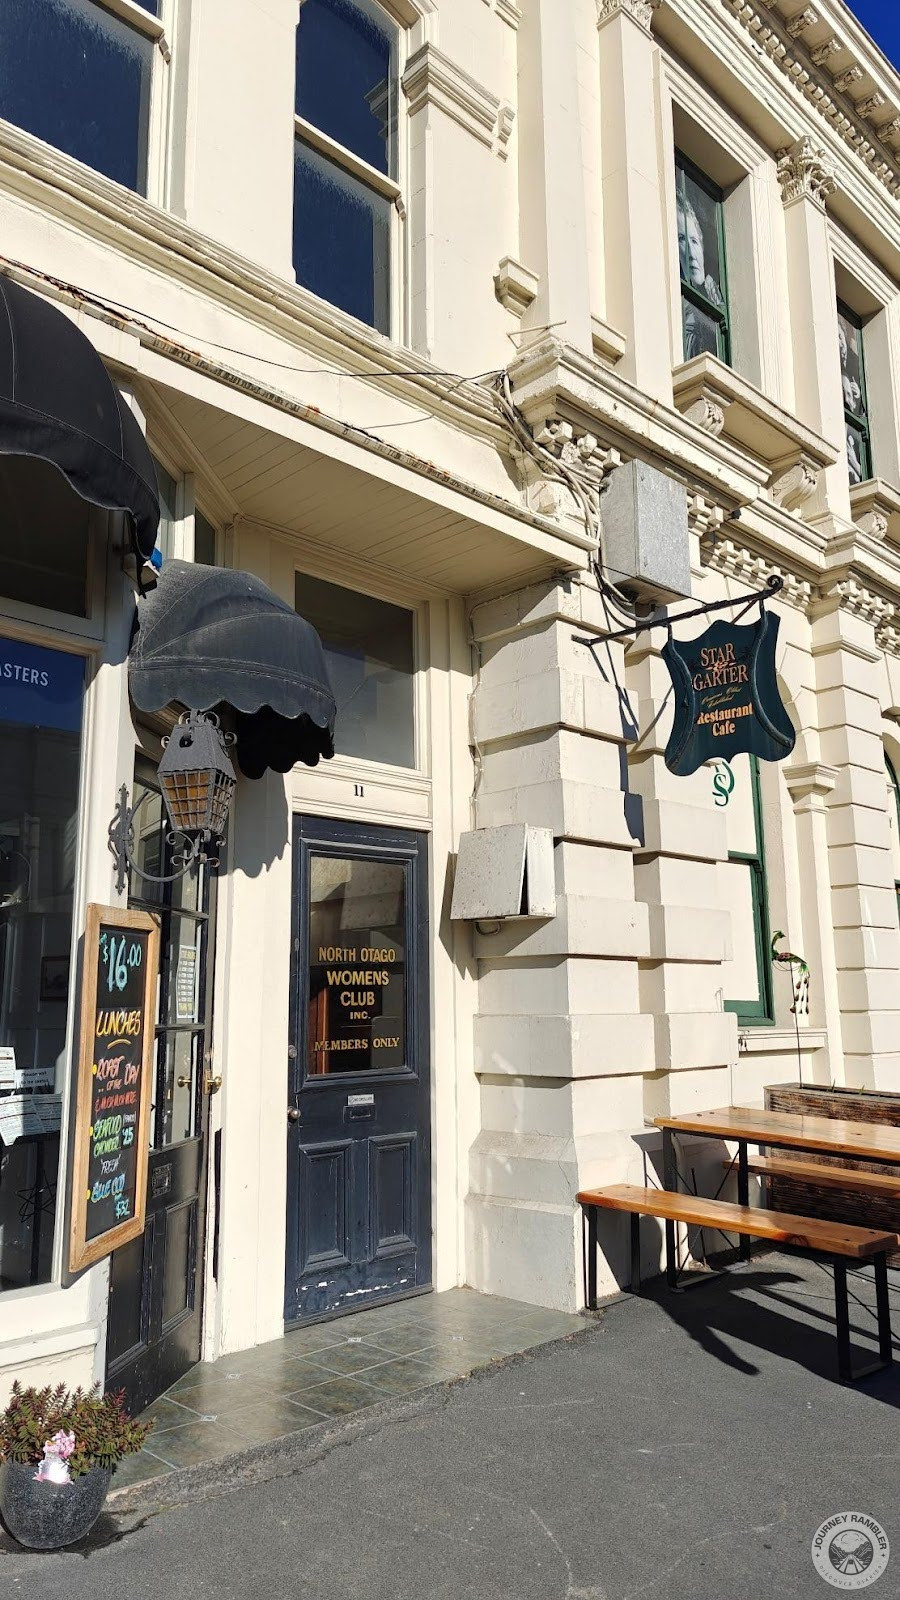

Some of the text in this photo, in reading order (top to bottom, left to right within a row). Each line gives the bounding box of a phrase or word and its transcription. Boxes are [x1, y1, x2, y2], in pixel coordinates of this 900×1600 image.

[701, 643, 735, 667] STAR
[0, 663, 49, 686] STERS
[693, 664, 749, 691] GARTER
[697, 702, 753, 725] Restaurant
[712, 720, 736, 737] Cafe
[103, 935, 142, 992] $16.00
[318, 946, 396, 963] NORTH OTAGO
[326, 970, 390, 986] WOMENS
[340, 991, 375, 1007] CLUB
[96, 1010, 141, 1037] LUNCHES
[350, 1011, 371, 1020] INC.
[314, 1037, 400, 1051] MEMBERS ONLY
[96, 1056, 125, 1081] ROAST
